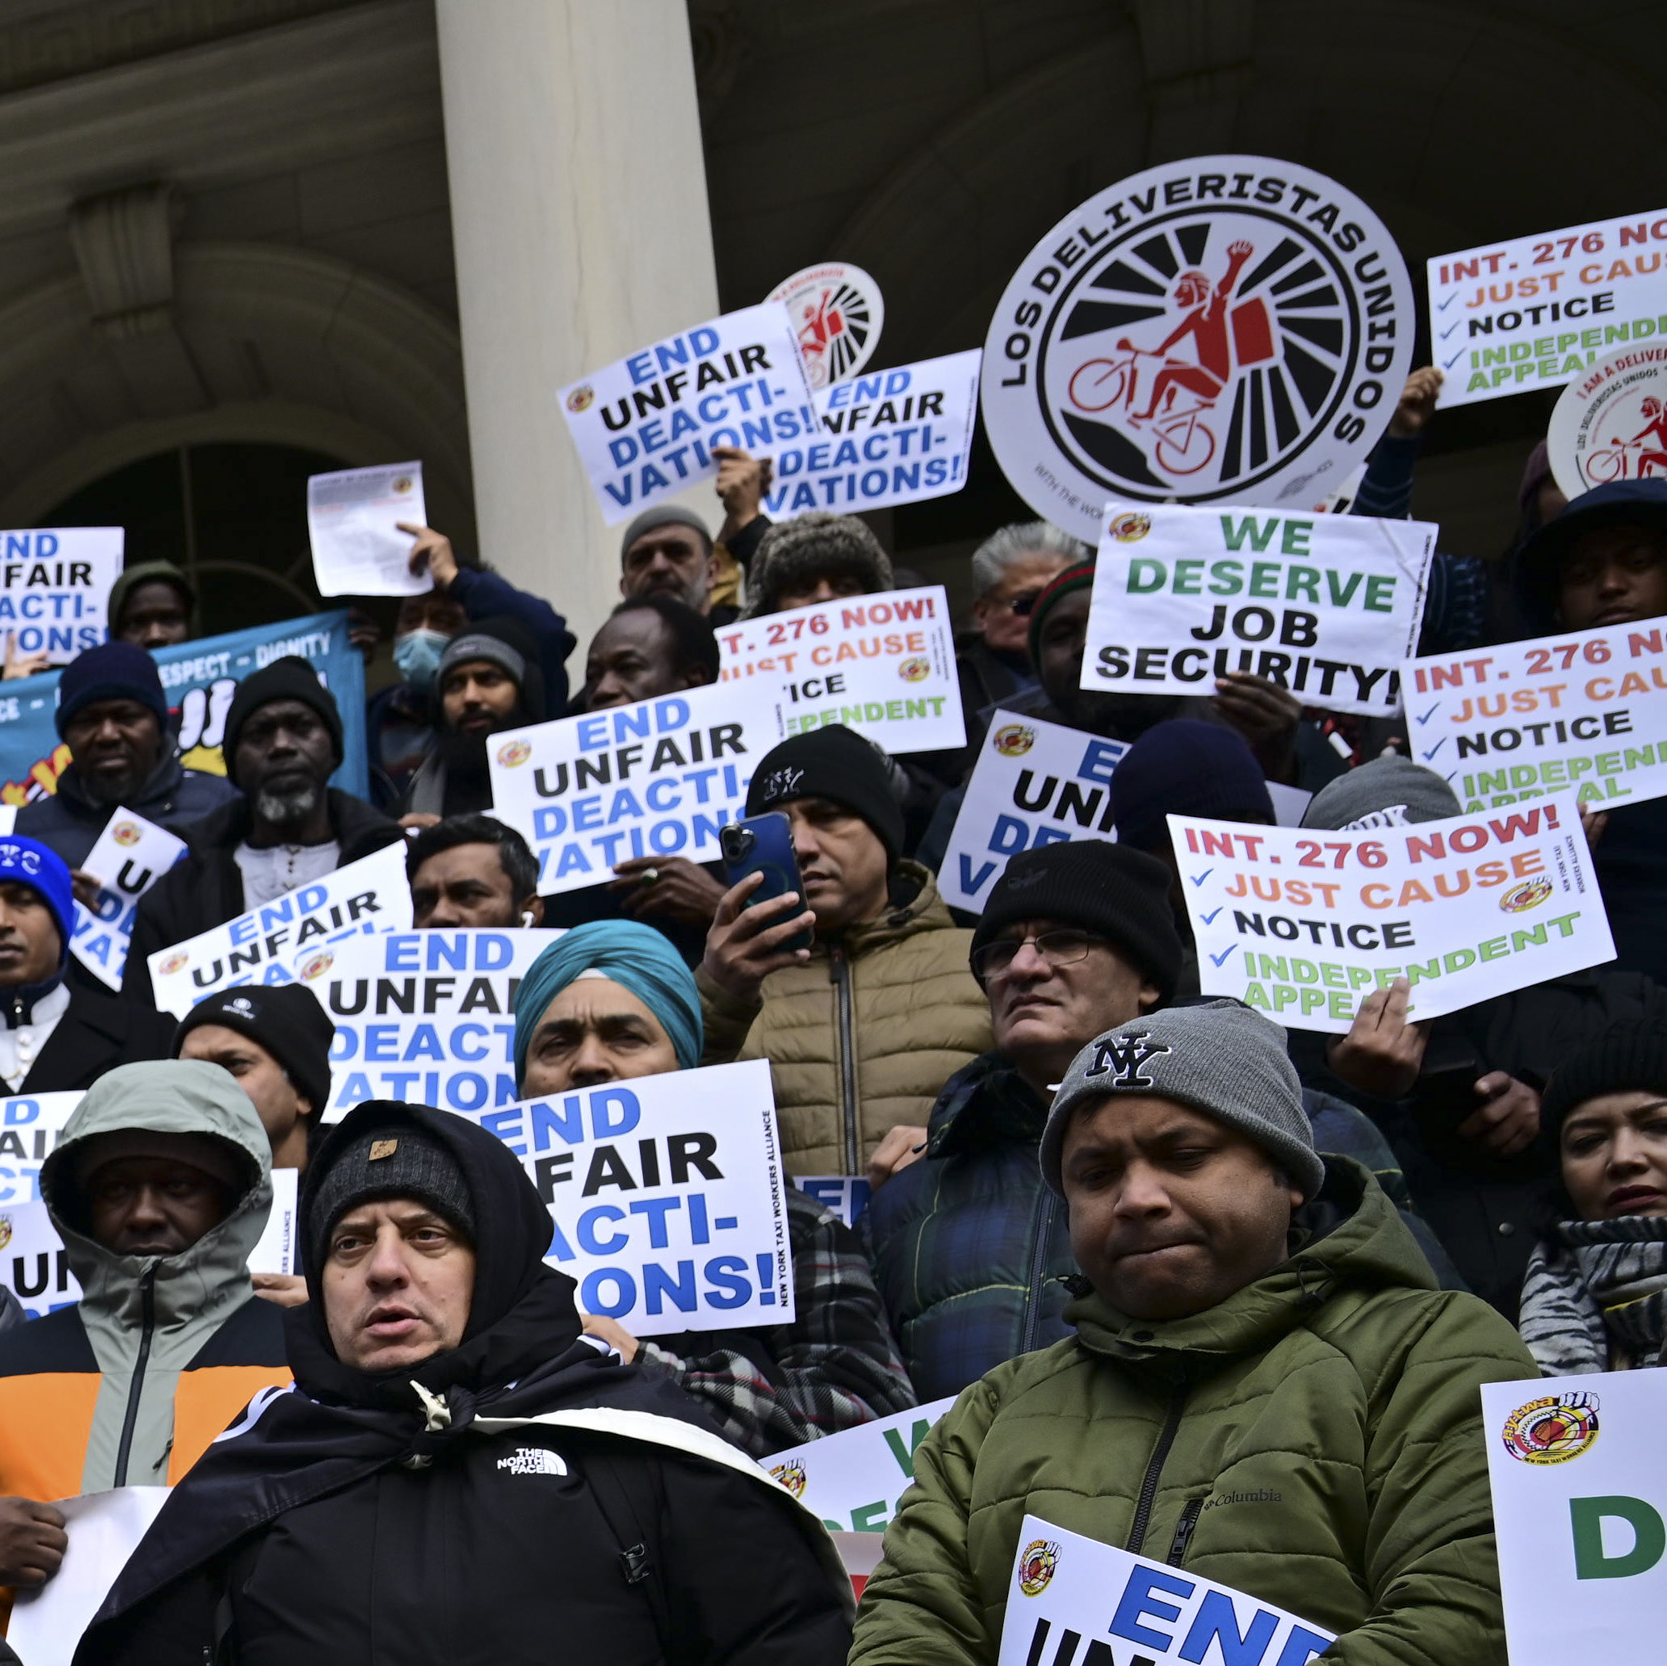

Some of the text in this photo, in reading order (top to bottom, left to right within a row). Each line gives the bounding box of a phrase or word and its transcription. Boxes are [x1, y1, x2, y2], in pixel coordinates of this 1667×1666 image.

[1439, 233, 1604, 284] INT. 276
[1002, 174, 1396, 443] LOS DELIVERISTAS UNIDOS
[1466, 272, 1564, 308] JUST
[1468, 291, 1615, 337] NOTICE
[627, 327, 719, 384] END
[1584, 373, 1604, 394] AM
[1604, 365, 1615, 376] A
[600, 344, 772, 431] UNFAIR
[828, 371, 912, 409] END
[609, 378, 785, 468] DEACTI-
[604, 406, 812, 507] VATIONS!
[779, 425, 946, 477] DEACTI-
[765, 456, 960, 512] VATIONS!
[1220, 515, 1314, 556] WE
[1126, 558, 1397, 613] DESERVE
[768, 597, 935, 646] 276 NOW!
[1191, 605, 1318, 647] JOB
[811, 632, 926, 666] CAUSE
[1415, 639, 1612, 693] INT. 276
[1096, 646, 1400, 705] SECURITY!
[577, 698, 690, 752] END
[1450, 684, 1567, 723] JUST
[534, 723, 747, 797] UNFAIR
[1457, 710, 1633, 759] NOTICE
[1185, 805, 1560, 869] INT. 276 NOW!
[1225, 849, 1546, 909] JUST CAUSE
[192, 891, 381, 987] UNFAIR
[229, 885, 328, 947] END
[1234, 910, 1415, 949] NOTICE
[385, 934, 514, 971] END
[1244, 911, 1581, 990] INDEPENDENT
[761, 1110, 789, 1307] NEW YORK TAXI WORKERS ALLIANCE
[497, 1457, 544, 1469] NORTH
[511, 1465, 545, 1474] FACE
[516, 1448, 543, 1457] THE
[1214, 1489, 1282, 1506] Columbia
